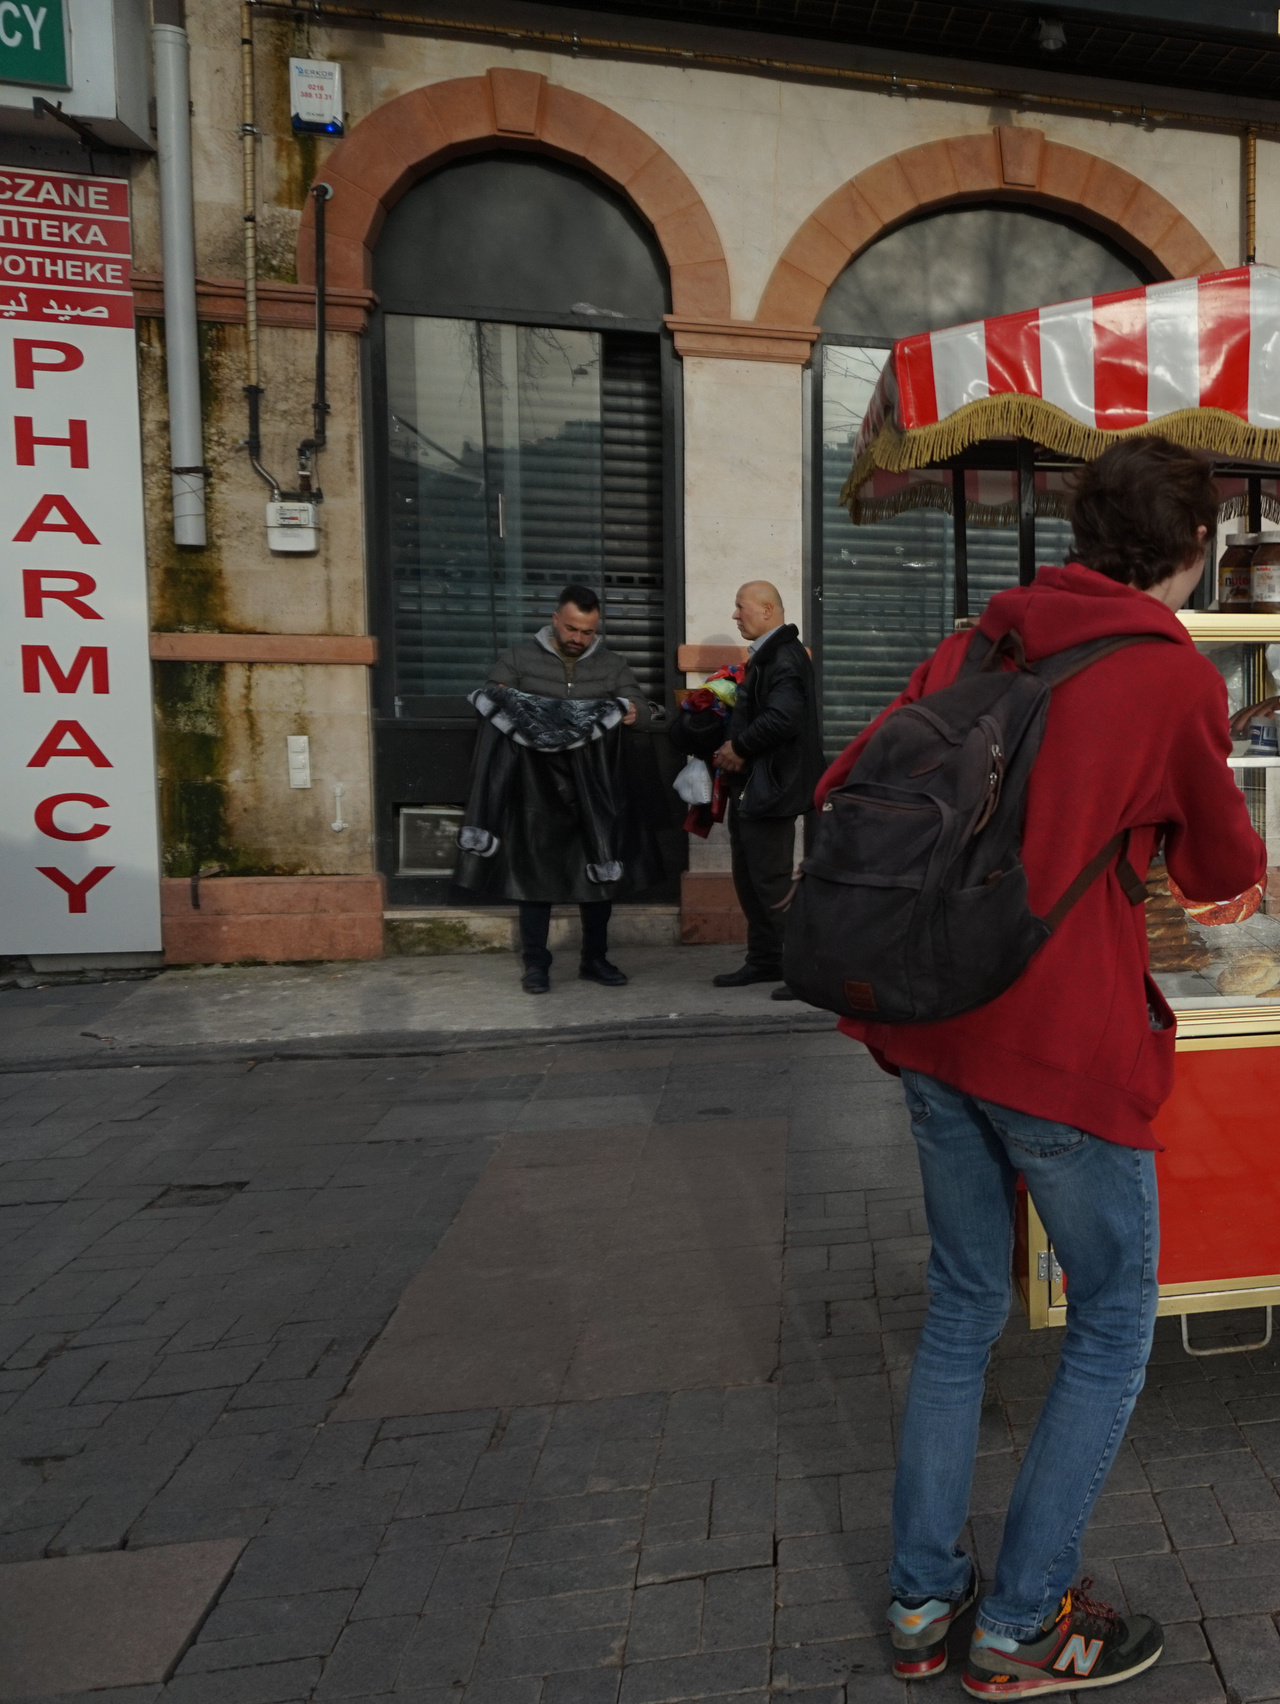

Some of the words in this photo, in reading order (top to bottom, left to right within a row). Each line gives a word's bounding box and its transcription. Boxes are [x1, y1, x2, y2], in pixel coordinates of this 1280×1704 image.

[0, 255, 123, 284] OTHEKE
[12, 338, 116, 915] PHARMACY
[1053, 1633, 1104, 1679] N
